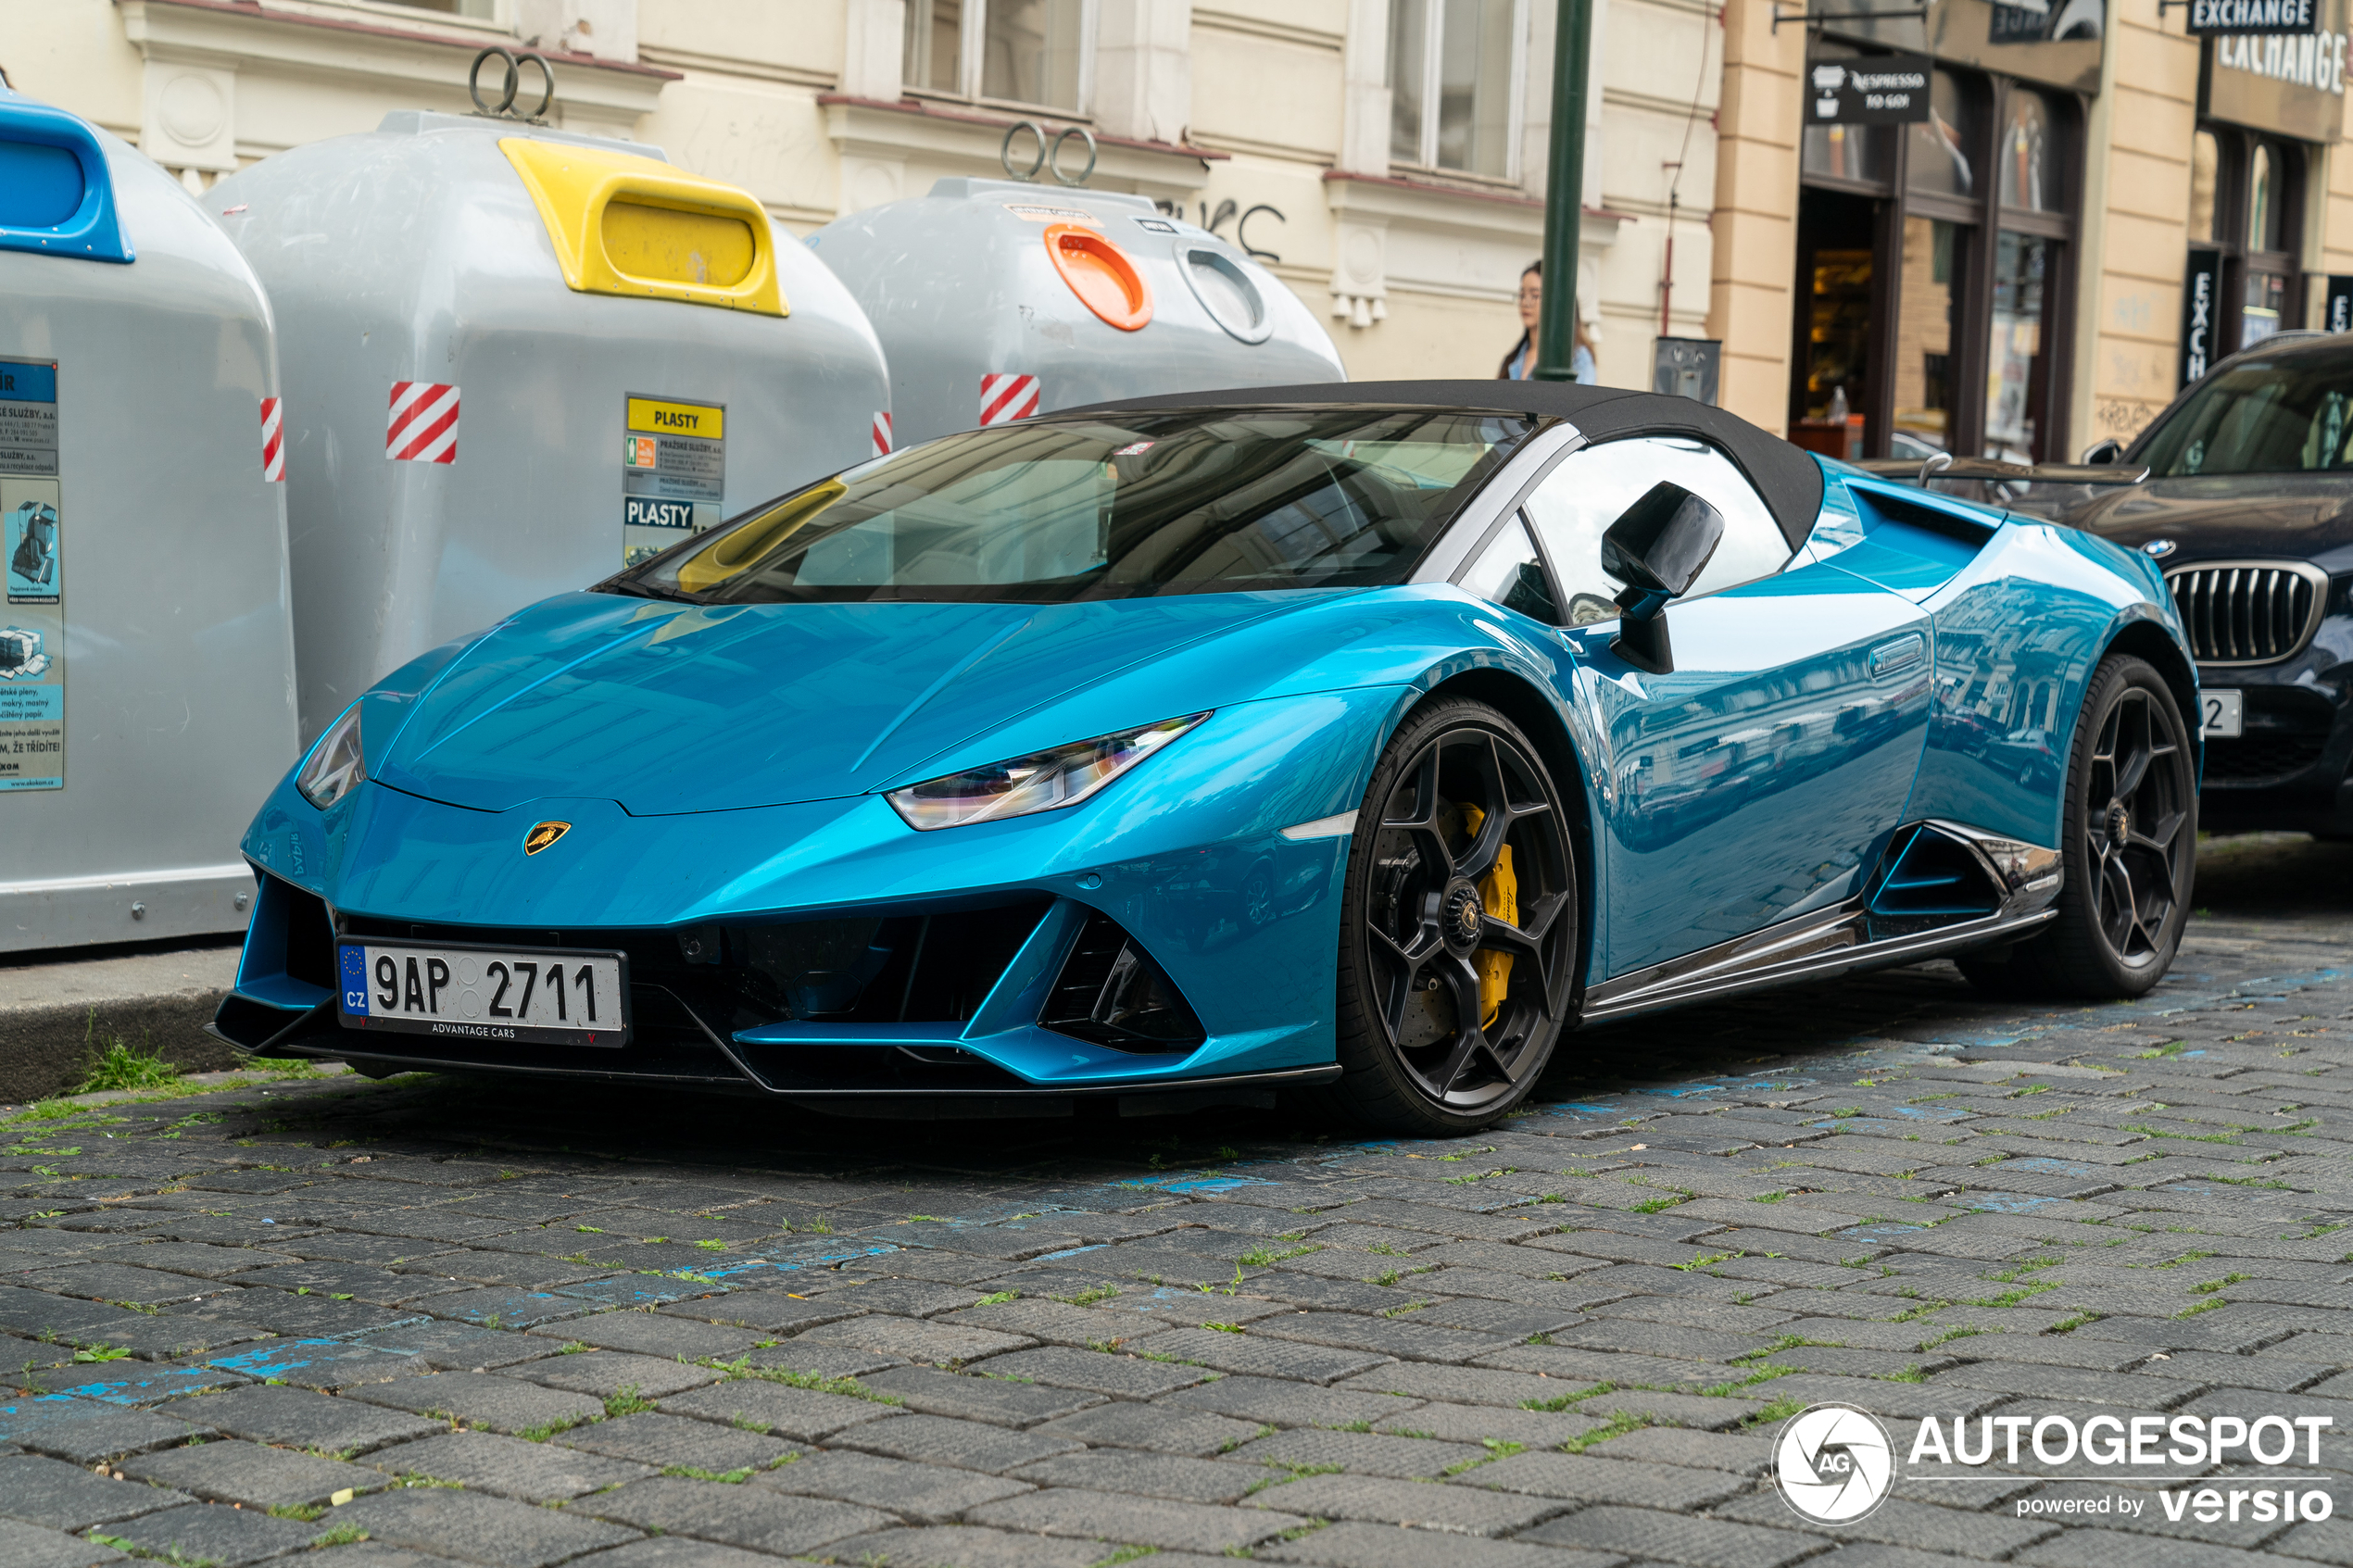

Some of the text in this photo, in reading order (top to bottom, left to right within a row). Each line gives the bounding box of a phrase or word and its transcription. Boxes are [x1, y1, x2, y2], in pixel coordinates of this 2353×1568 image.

[2192, 0, 2311, 27] EXCHANGE
[1850, 69, 1926, 93] NESPRESSO
[1865, 94, 1884, 109] TO
[654, 410, 698, 429] PLASTY
[627, 501, 691, 527] PLASTY
[12, 740, 24, 754] ŽE
[374, 954, 598, 1022] 9AP 2711
[346, 991, 366, 1009] CZ
[432, 1022, 515, 1039] ADVANTAGE CARS
